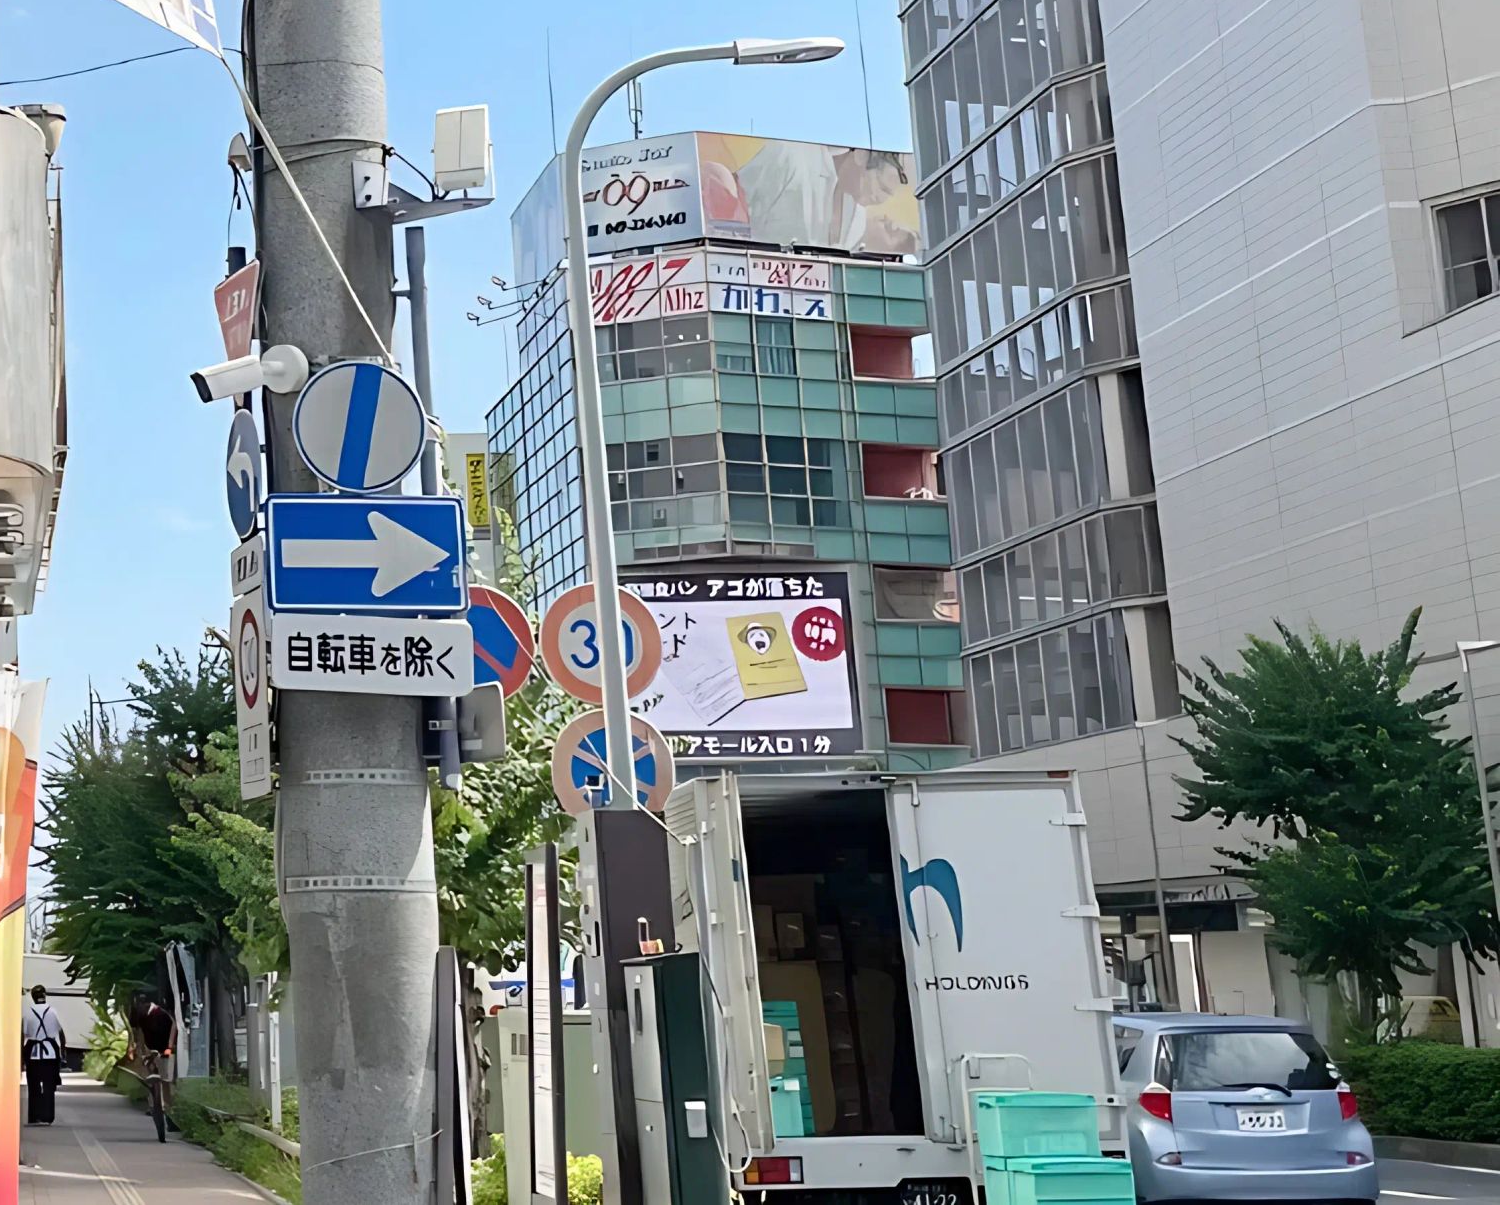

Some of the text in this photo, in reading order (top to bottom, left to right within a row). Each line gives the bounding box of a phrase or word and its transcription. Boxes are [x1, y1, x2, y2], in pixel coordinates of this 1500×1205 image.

[287, 631, 456, 681] 自転車を除く
[925, 974, 1030, 991] HOLDINGS
